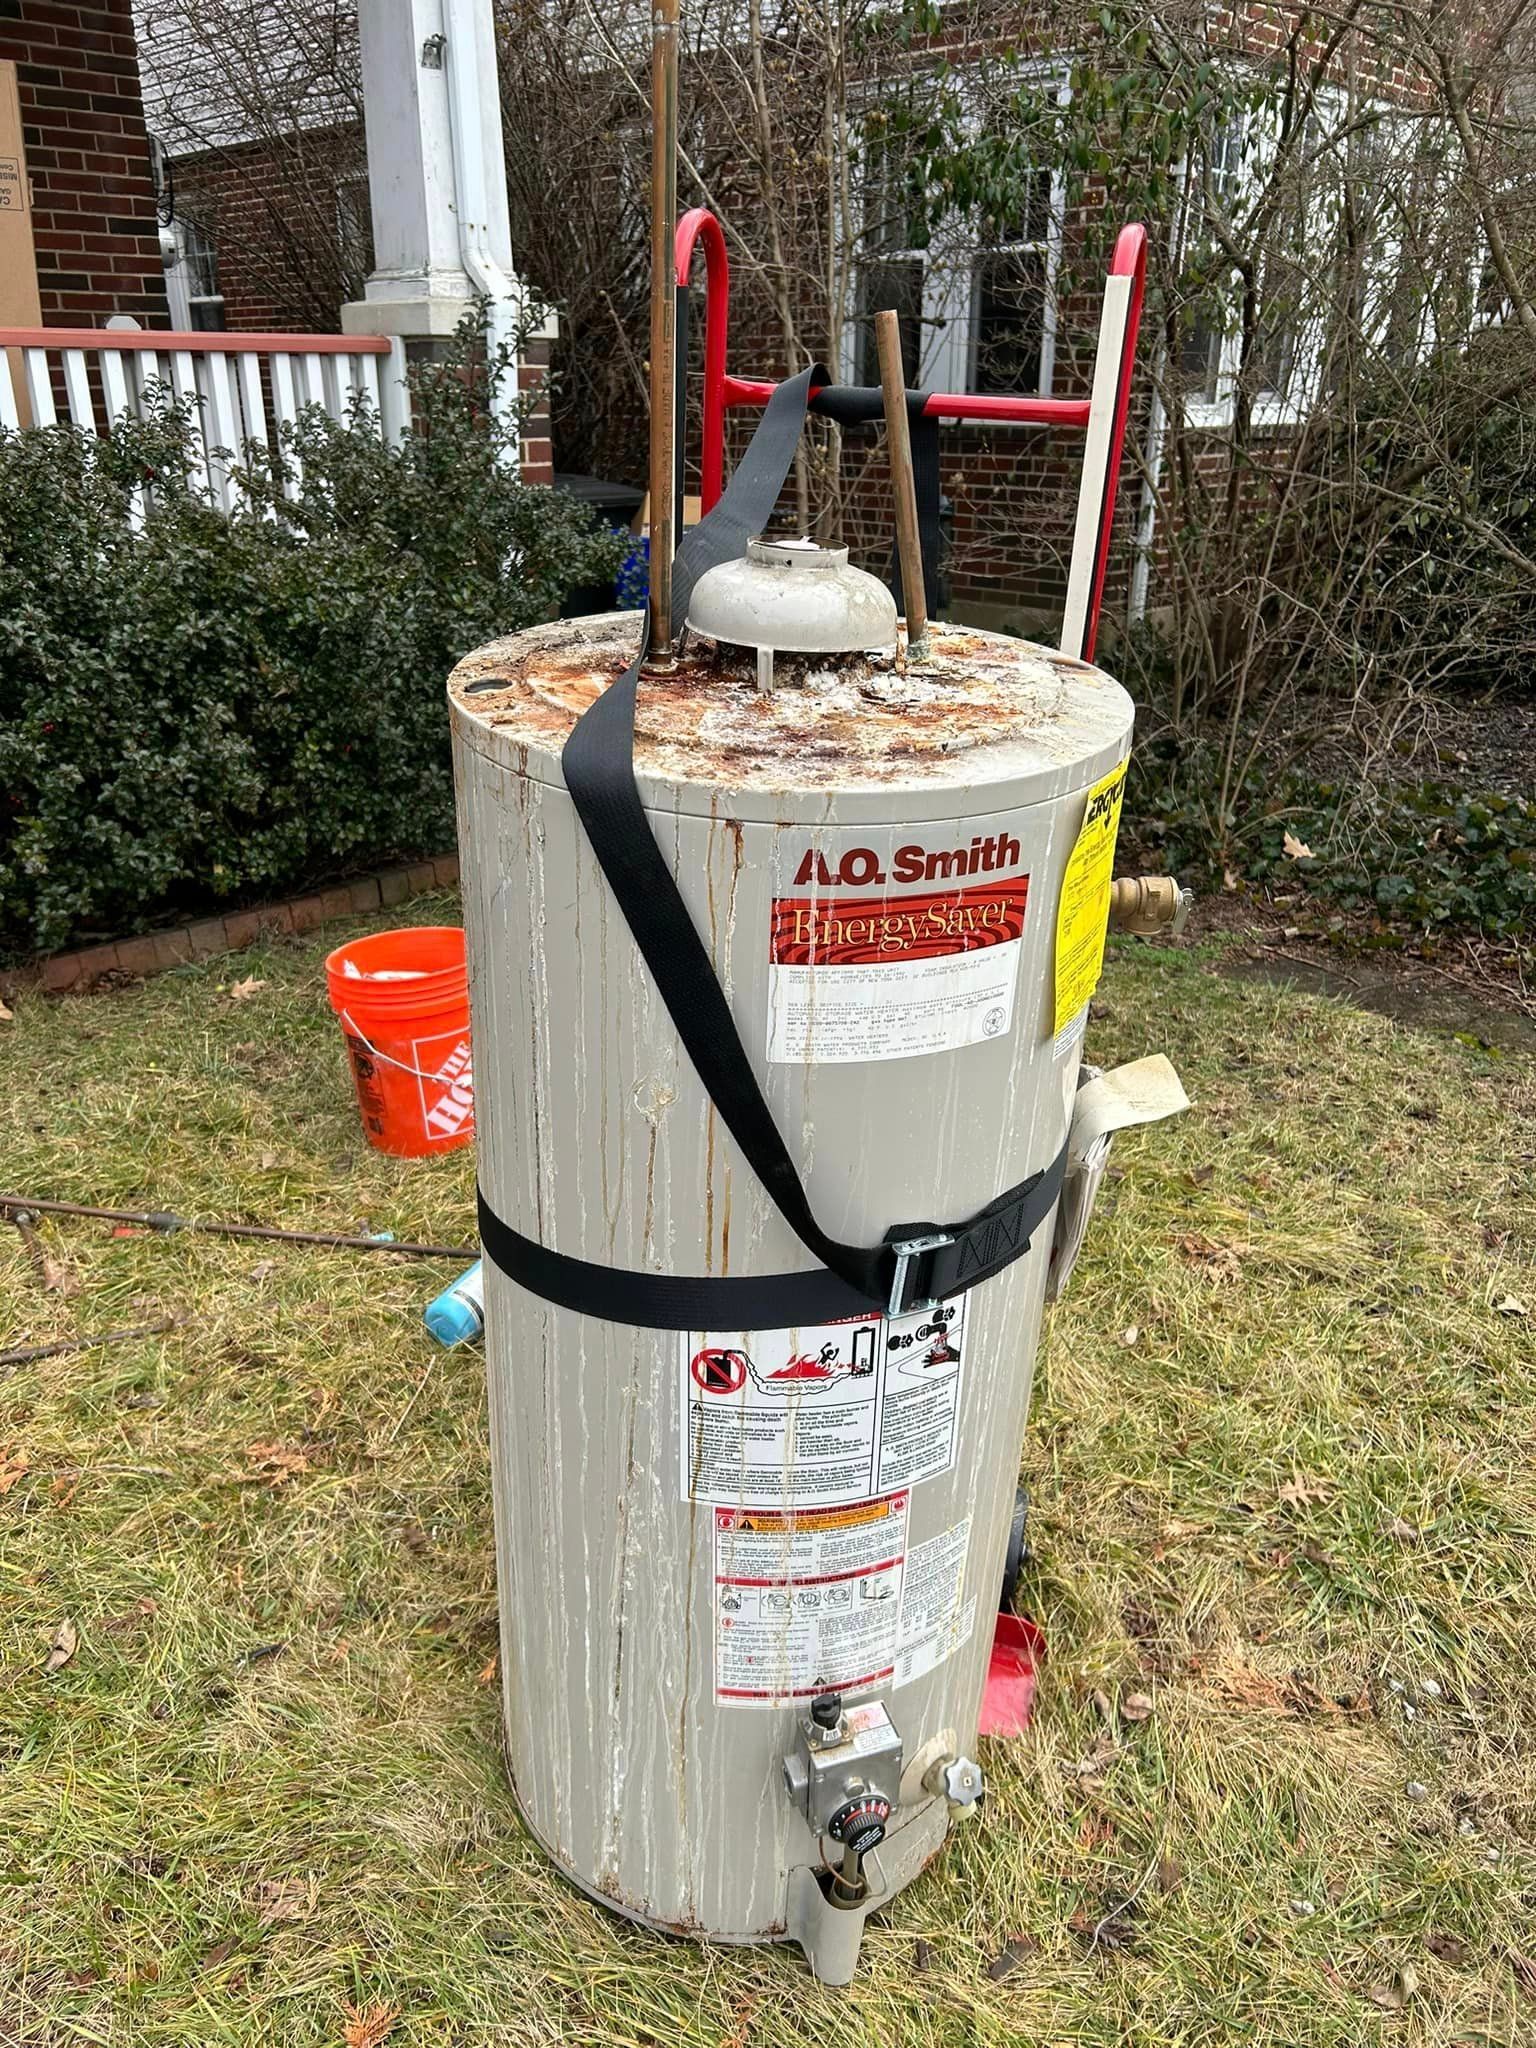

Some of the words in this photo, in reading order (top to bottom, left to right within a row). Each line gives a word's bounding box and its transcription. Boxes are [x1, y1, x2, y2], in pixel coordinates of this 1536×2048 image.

[793, 848, 886, 886] A.O.
[893, 832, 1020, 883] Smith
[791, 897, 1014, 952] EnergySaver
[427, 1056, 473, 1133] HO
